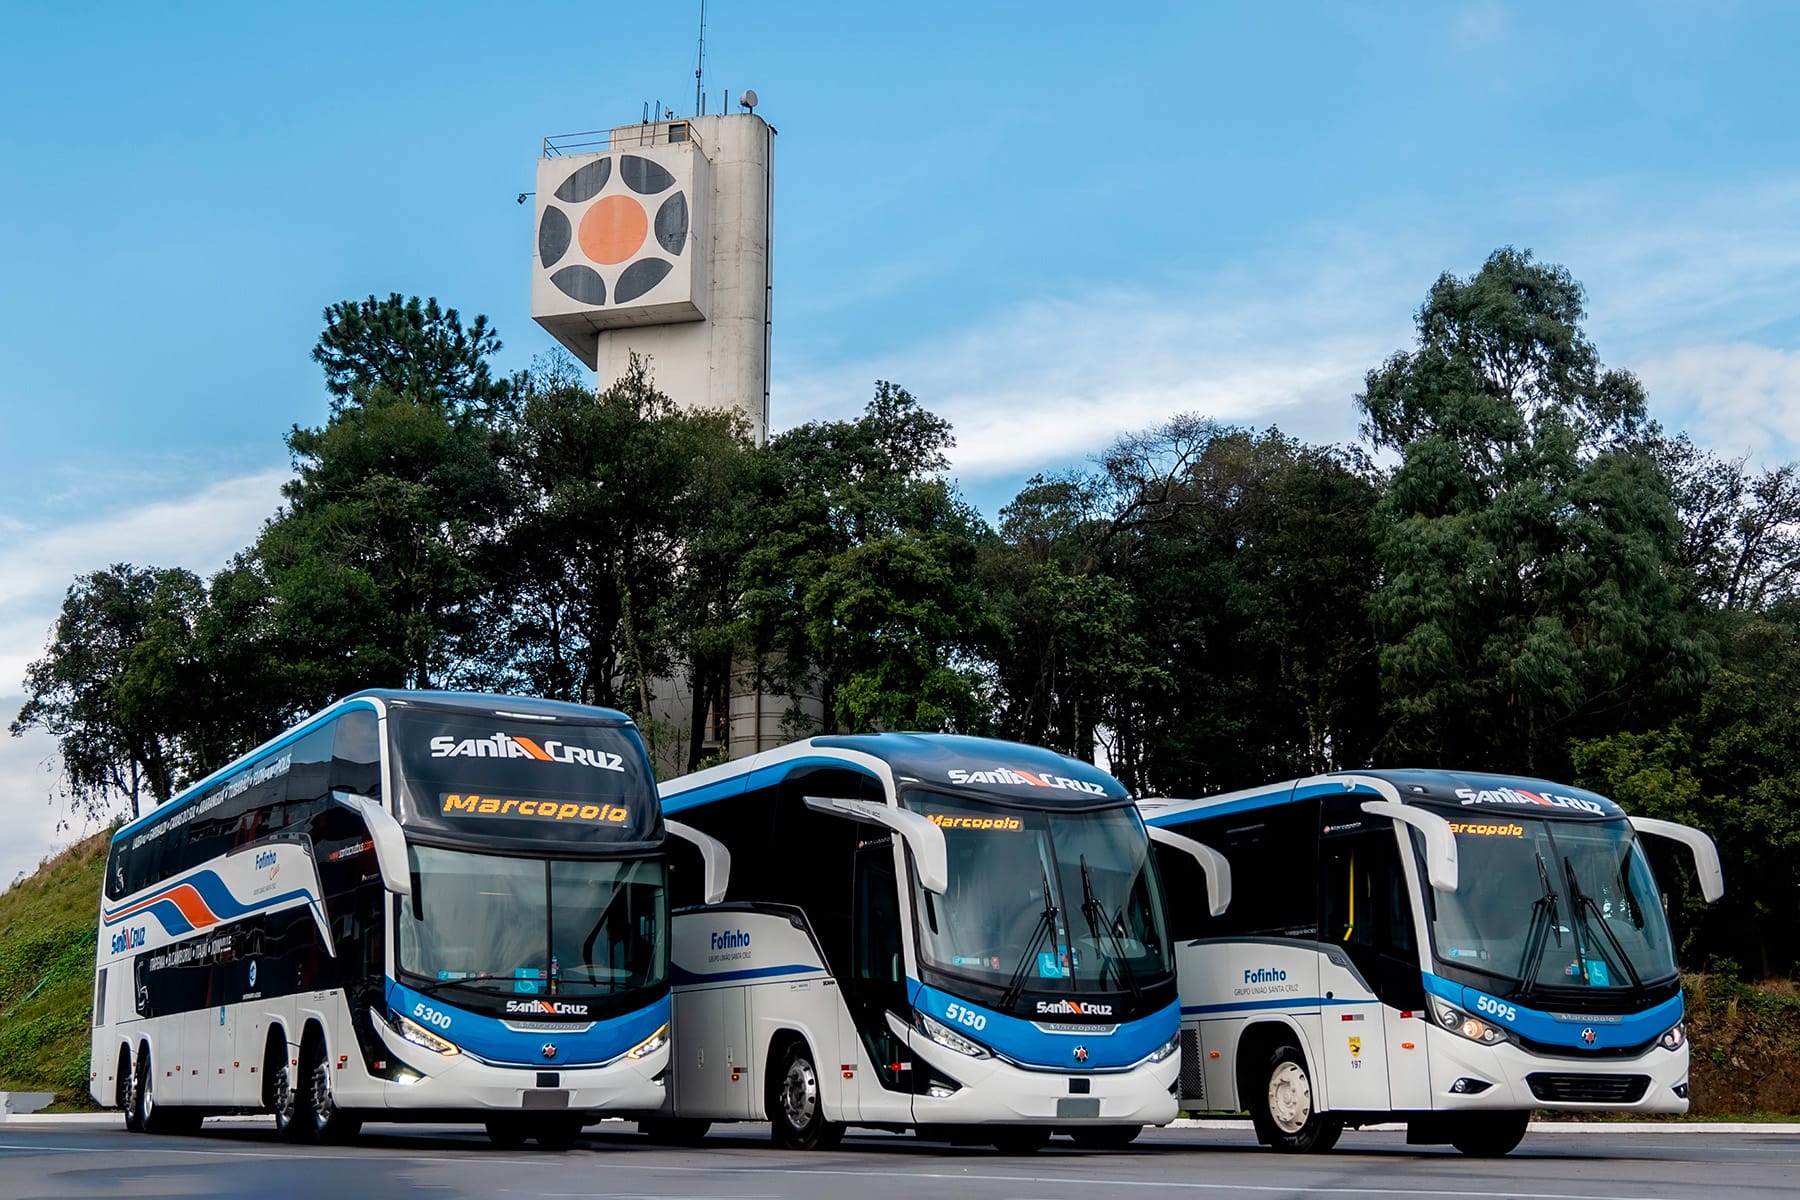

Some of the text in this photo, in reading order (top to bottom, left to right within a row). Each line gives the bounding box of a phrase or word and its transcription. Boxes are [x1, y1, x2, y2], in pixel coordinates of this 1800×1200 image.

[545, 741, 625, 772] CRUZ
[1043, 773, 1109, 797] CRUZ
[443, 794, 628, 822] Marcopolo
[1546, 794, 1605, 816] CRUZ
[1446, 820, 1523, 836] arcopolo
[711, 929, 750, 950] Fofinho
[1244, 967, 1286, 984] Fofinho
[1268, 985, 1284, 993] SANTA
[1285, 983, 1299, 992] CRUZ
[413, 1002, 451, 1029] 5300
[553, 1002, 588, 1015] CRUZ
[945, 1003, 987, 1030] 5130
[1080, 1002, 1112, 1015] CRUZ
[1477, 995, 1516, 1022] 5095
